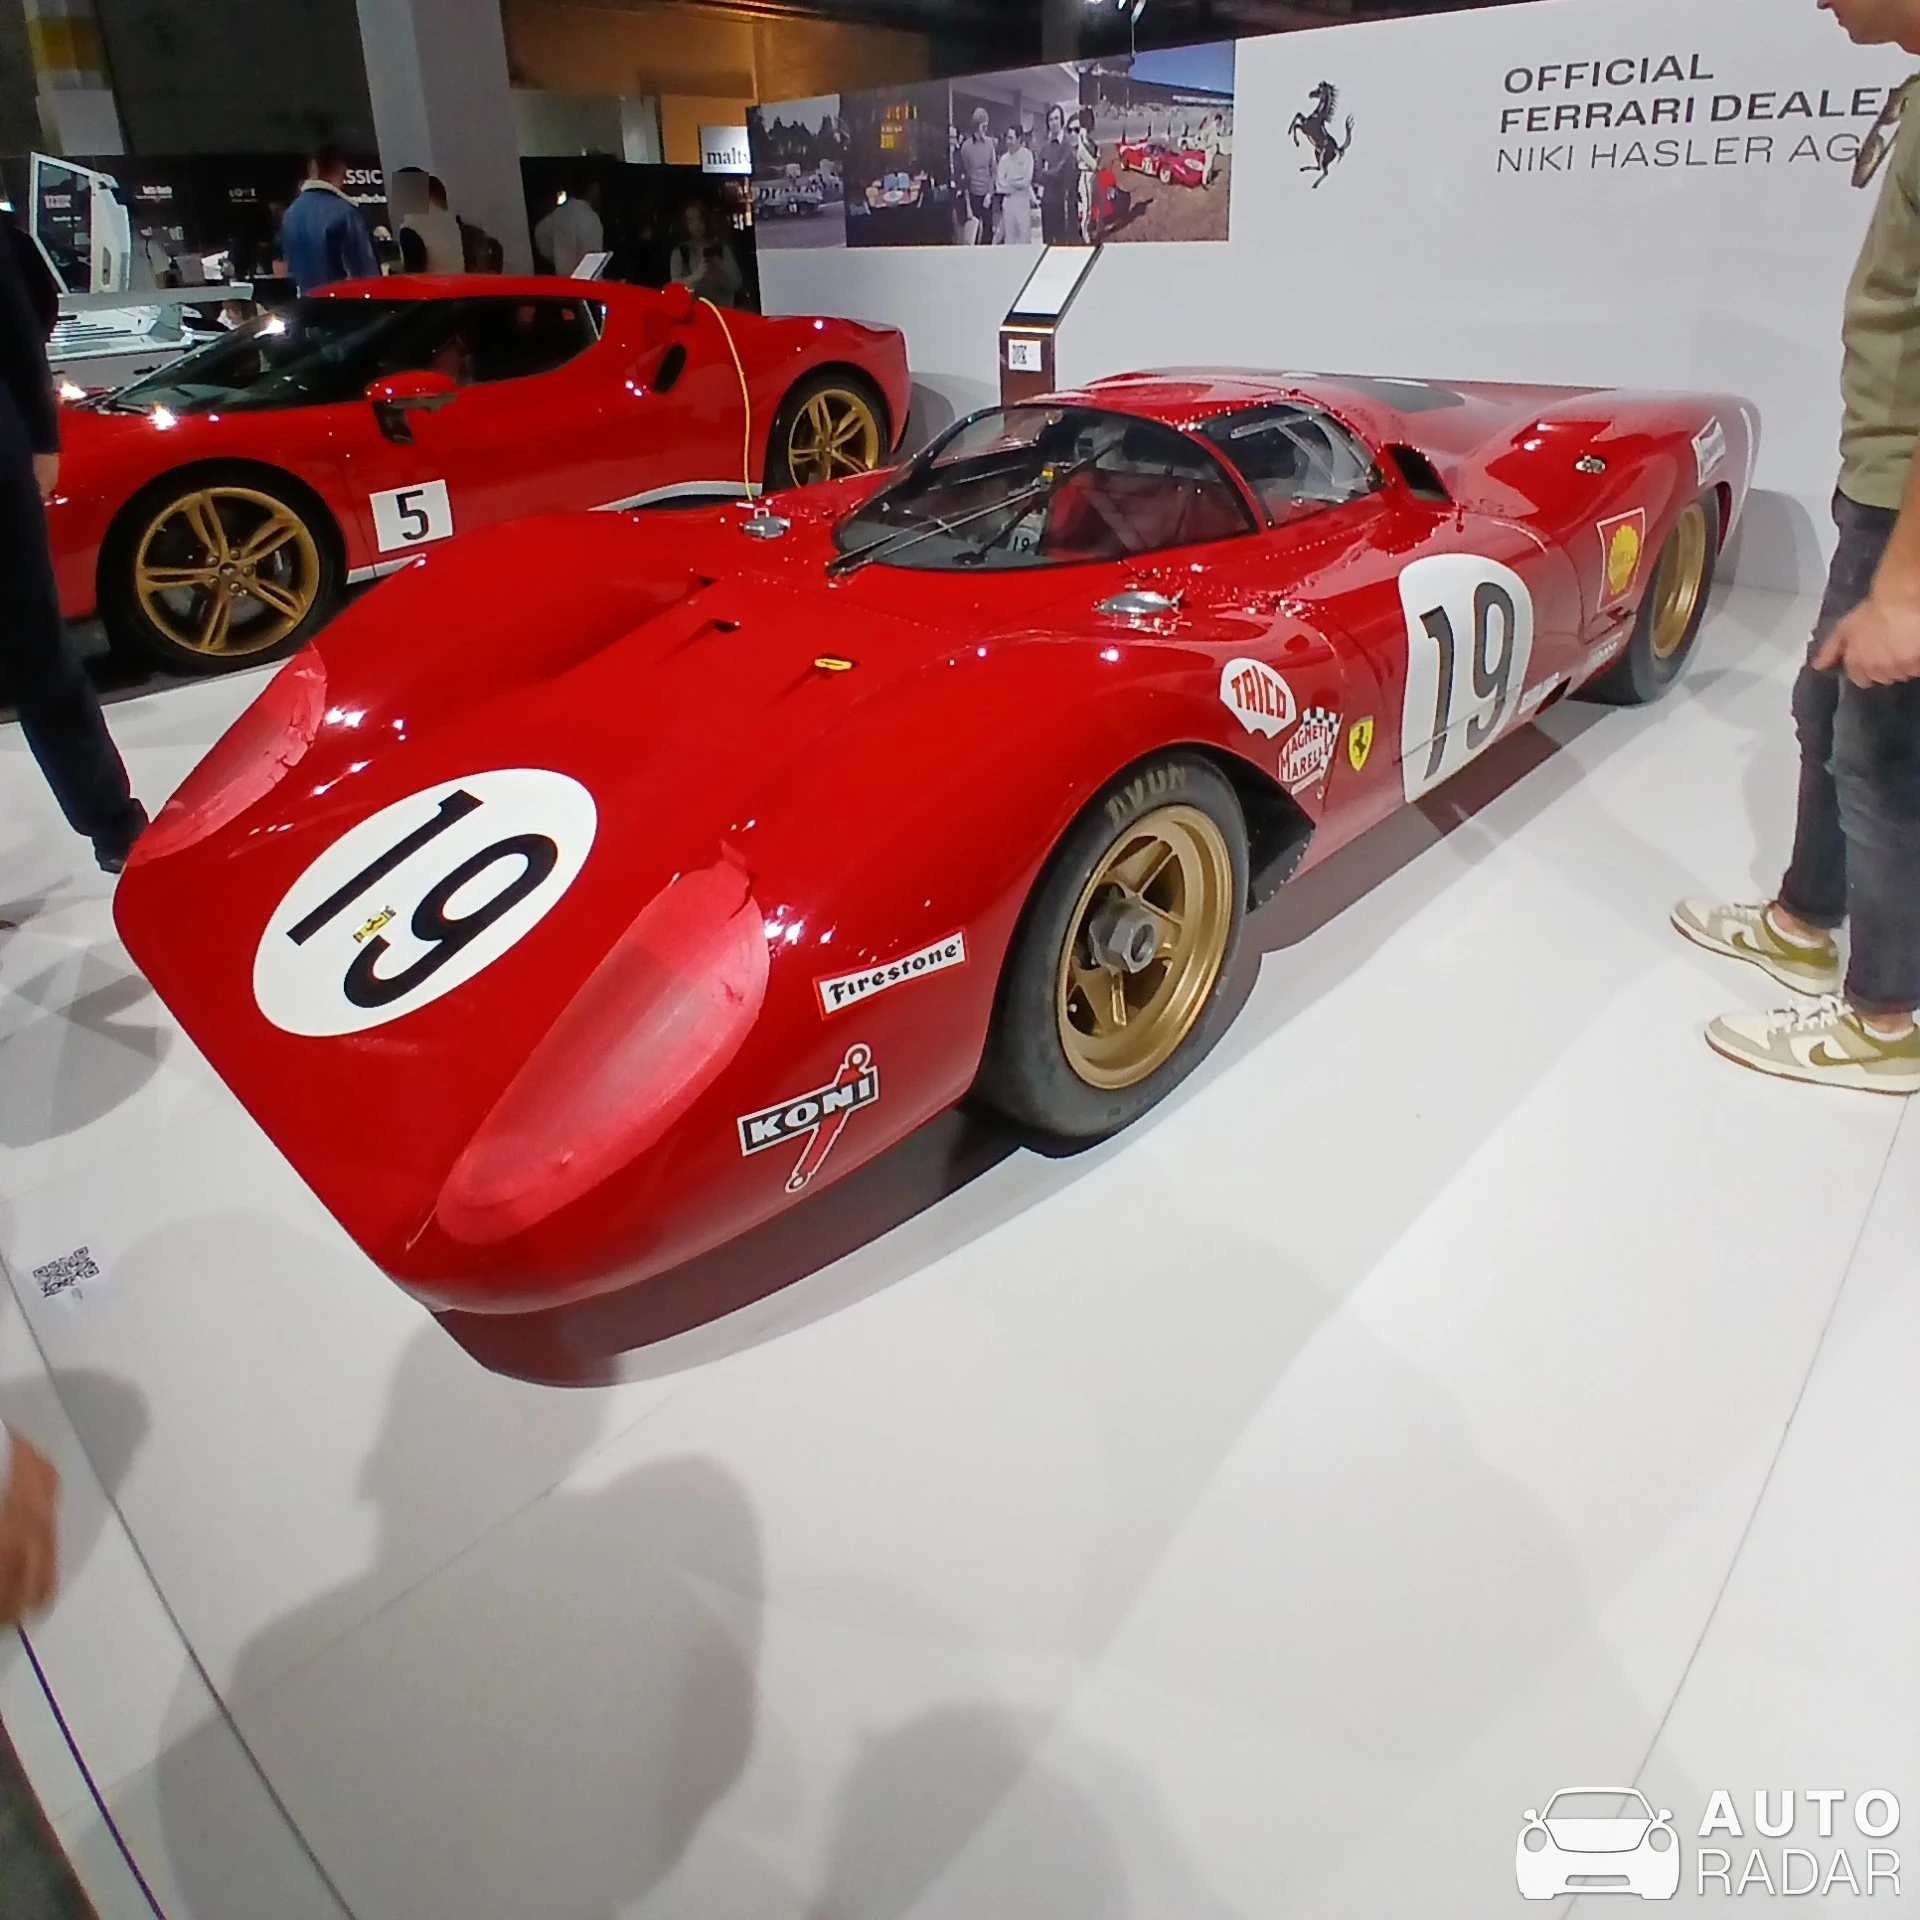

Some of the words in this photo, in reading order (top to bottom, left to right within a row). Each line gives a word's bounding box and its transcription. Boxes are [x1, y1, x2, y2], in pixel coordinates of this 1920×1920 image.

[1503, 54, 1714, 94] OFFICIAL
[1500, 97, 1695, 134] FERRARI
[343, 169, 383, 185] SSIC
[1497, 145, 1574, 172] NIKI
[1591, 136, 1774, 170] HASLER
[1788, 132, 1861, 163] AG
[396, 489, 429, 541] 5
[1013, 535, 1030, 553] 19
[1230, 665, 1287, 720] TRICO
[1419, 581, 1516, 781] 19
[286, 788, 559, 1009] 19
[828, 942, 960, 1005] Firestone
[750, 1076, 872, 1144] KONI
